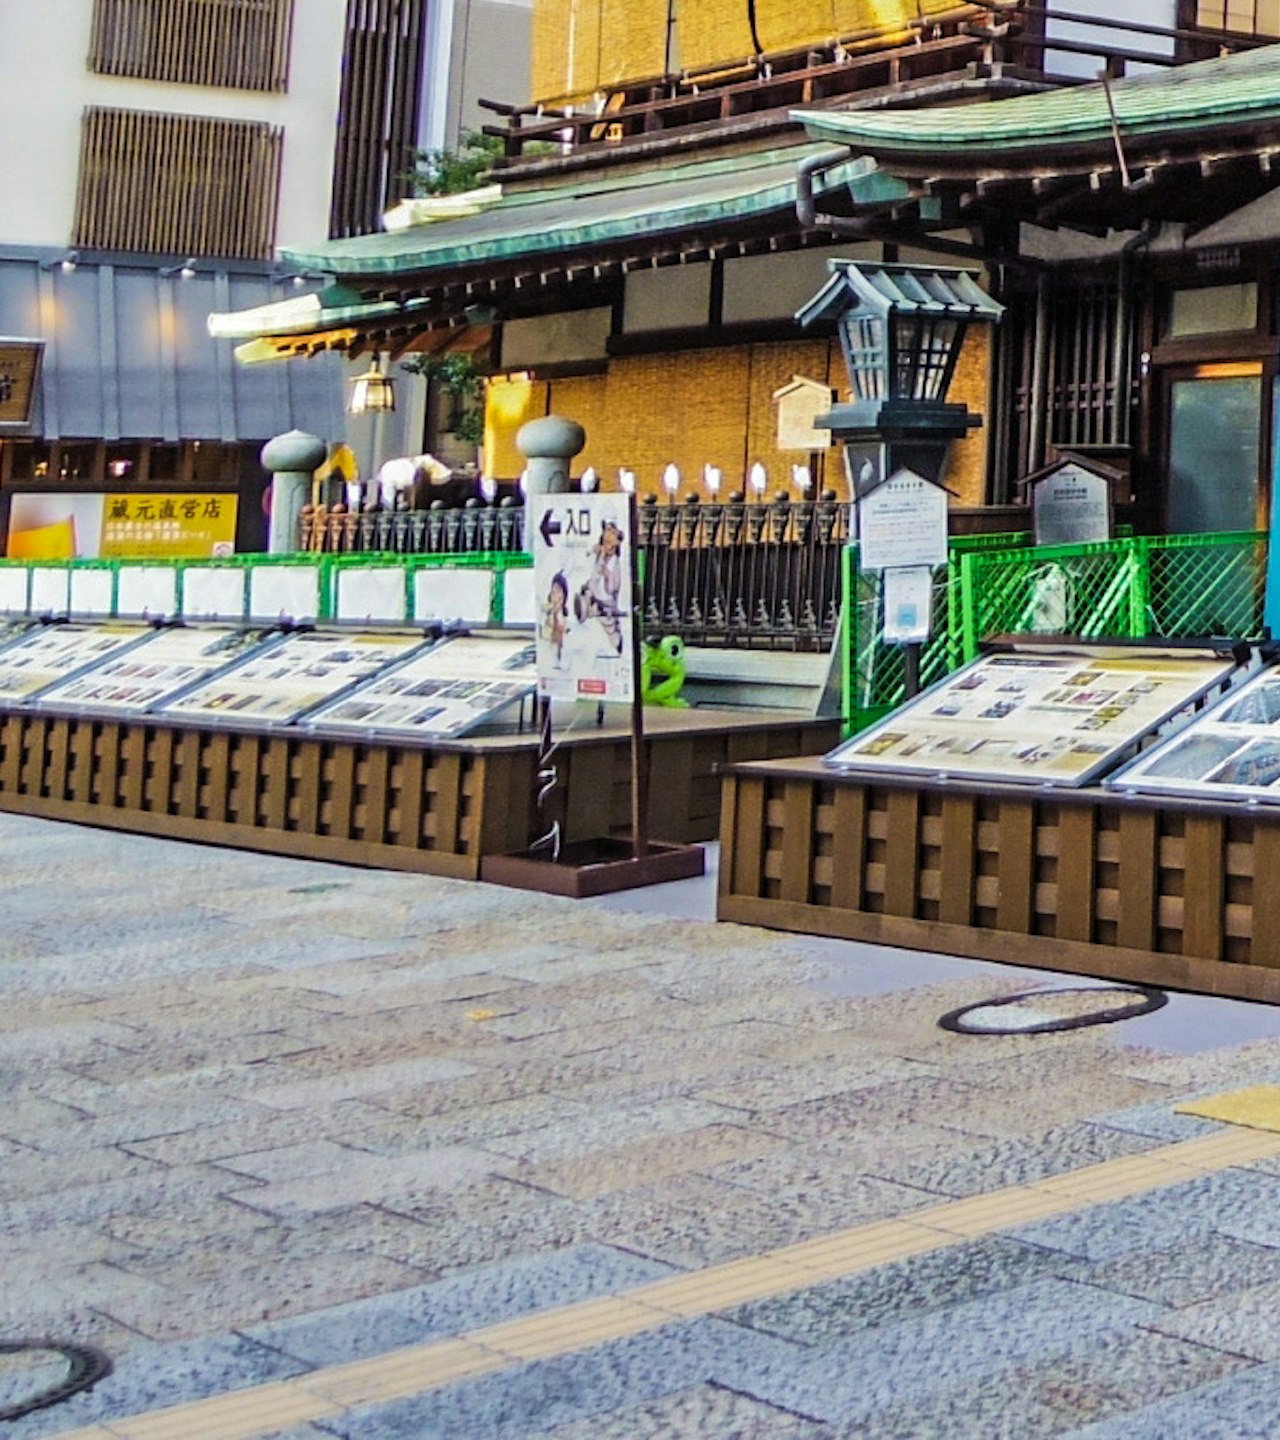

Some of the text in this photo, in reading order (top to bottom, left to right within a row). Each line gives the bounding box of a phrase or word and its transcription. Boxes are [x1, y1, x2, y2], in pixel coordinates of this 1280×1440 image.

[109, 498, 222, 520] 蔵元直営店
[565, 507, 591, 536] 入口
